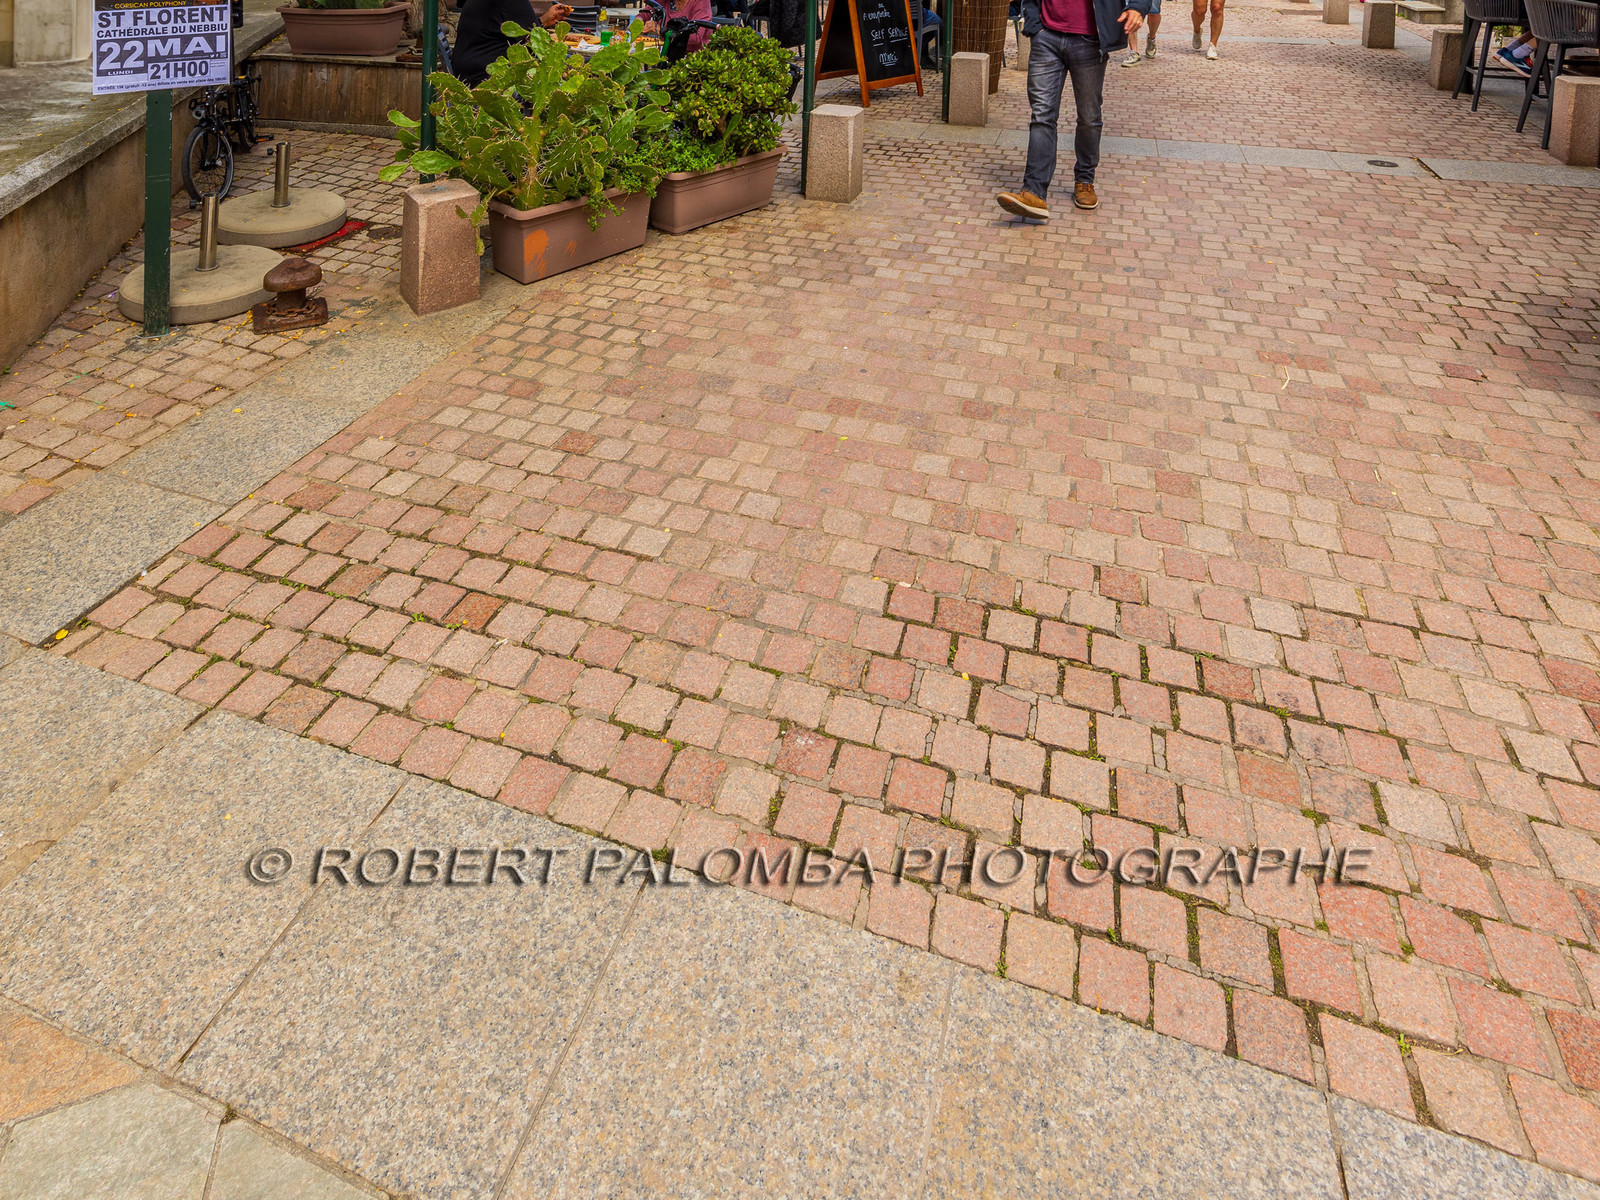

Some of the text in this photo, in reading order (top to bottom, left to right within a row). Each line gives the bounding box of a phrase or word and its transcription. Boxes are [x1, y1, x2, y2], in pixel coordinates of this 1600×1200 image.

[149, 0, 187, 8] POLYPHONY
[97, 6, 228, 28] ST FLORENT
[96, 23, 228, 38] CATHÉDRALE DU NEBBIU
[98, 35, 226, 70] 22 MAI
[149, 60, 209, 80] 21H00
